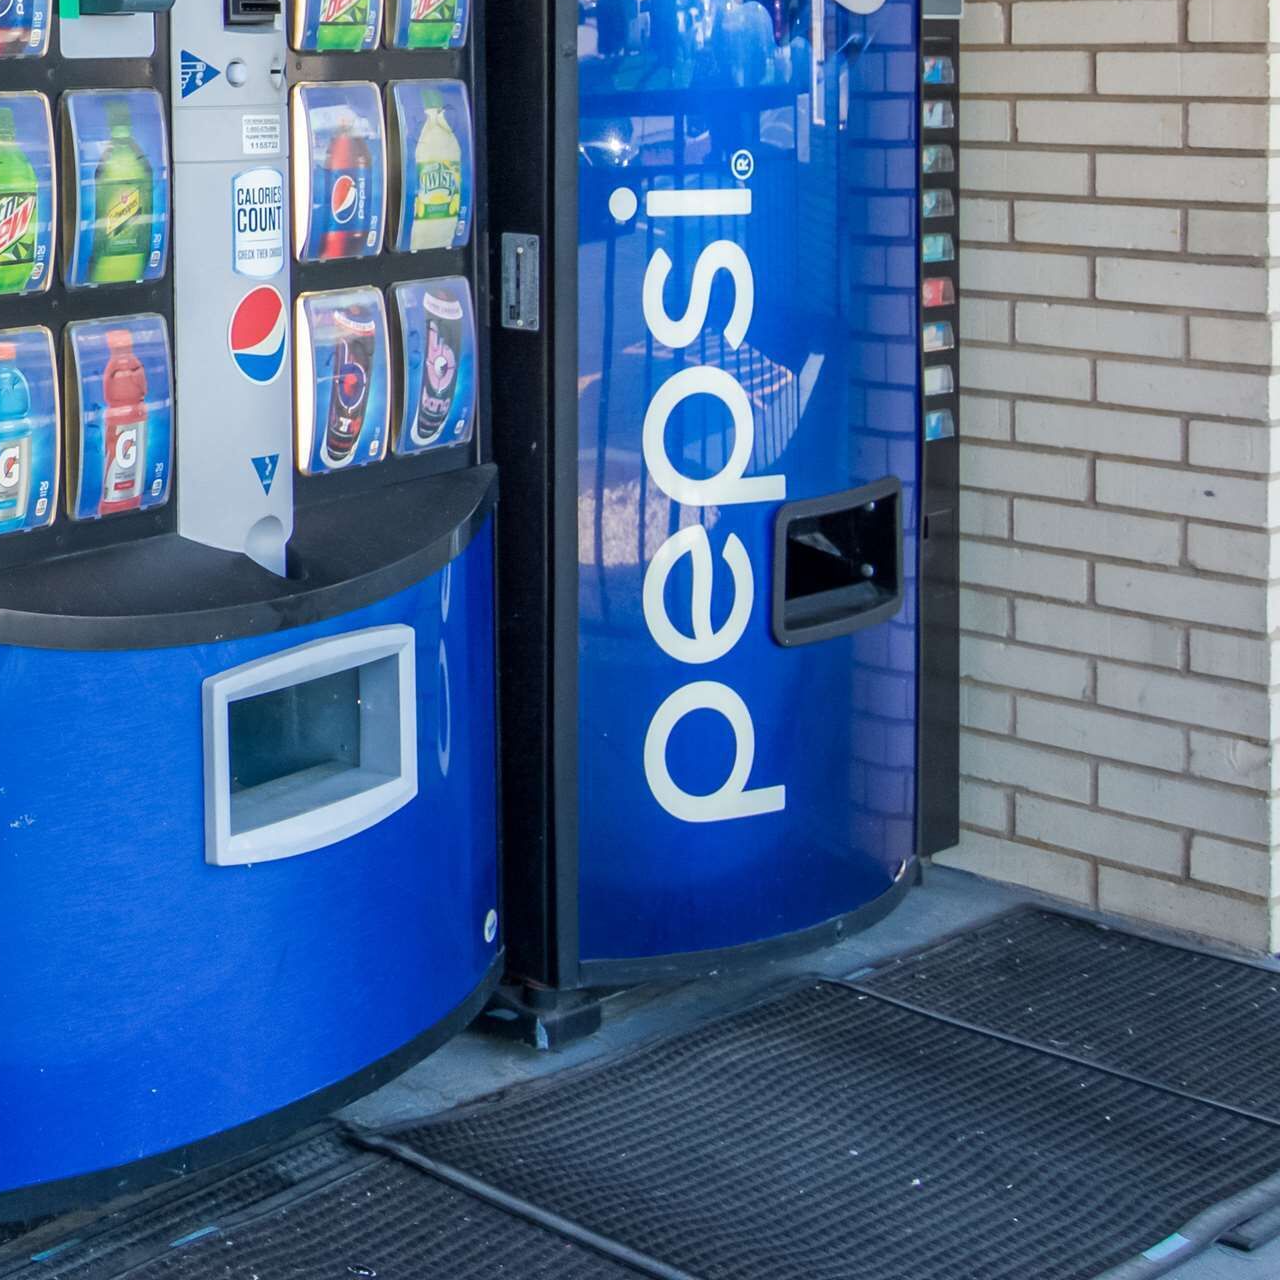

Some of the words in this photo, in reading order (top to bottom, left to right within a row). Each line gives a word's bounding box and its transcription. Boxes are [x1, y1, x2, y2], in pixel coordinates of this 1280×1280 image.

[237, 186, 281, 206] CALORIES
[237, 206, 282, 233] COUNT
[115, 429, 136, 468] G
[609, 186, 786, 823] pepsi
